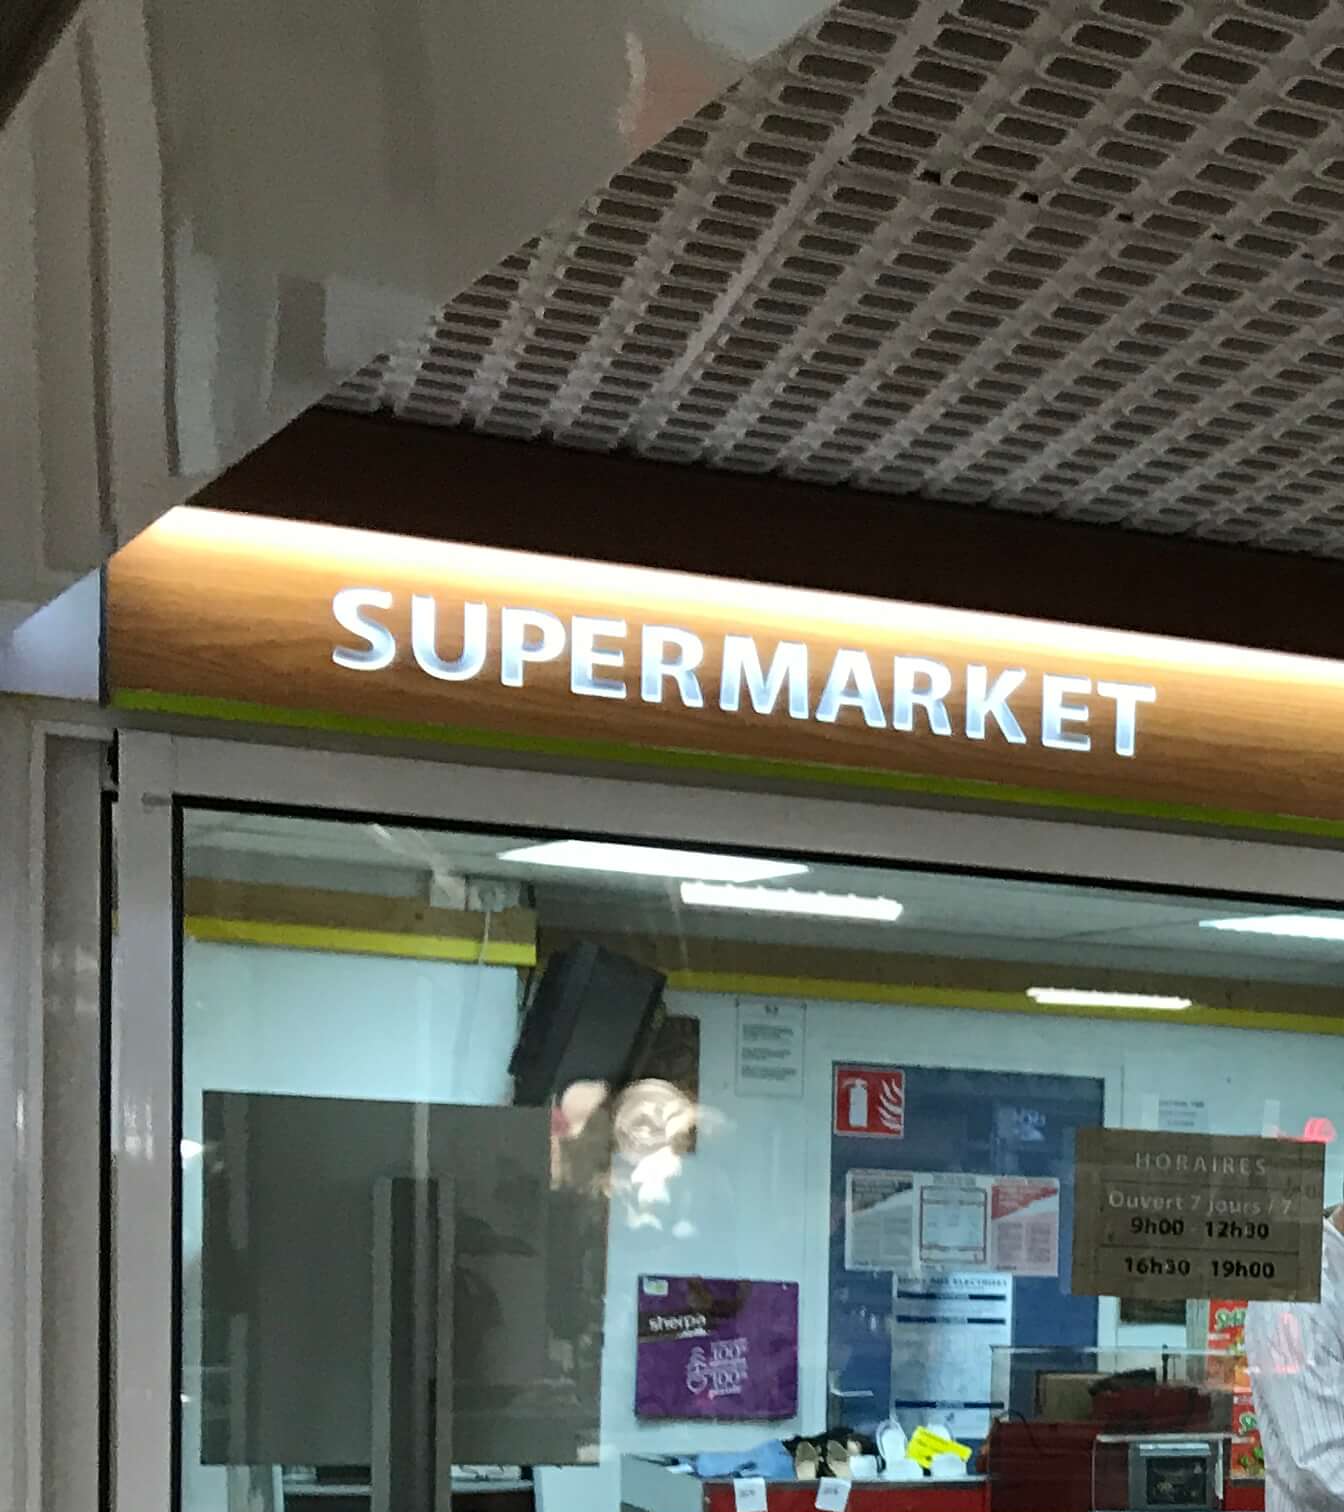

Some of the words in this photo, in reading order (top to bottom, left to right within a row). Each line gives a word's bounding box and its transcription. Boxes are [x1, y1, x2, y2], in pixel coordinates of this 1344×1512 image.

[331, 585, 1157, 758] SUPERMARKET
[1136, 1151, 1267, 1176] HORAIRES
[1109, 1190, 1183, 1210] Ouvert
[1130, 1217, 1185, 1236] 9h00
[1205, 1220, 1270, 1240] 12h30
[1124, 1256, 1191, 1276] 16h30
[1211, 1259, 1275, 1279] 19h00
[649, 1313, 707, 1332] sherpa
